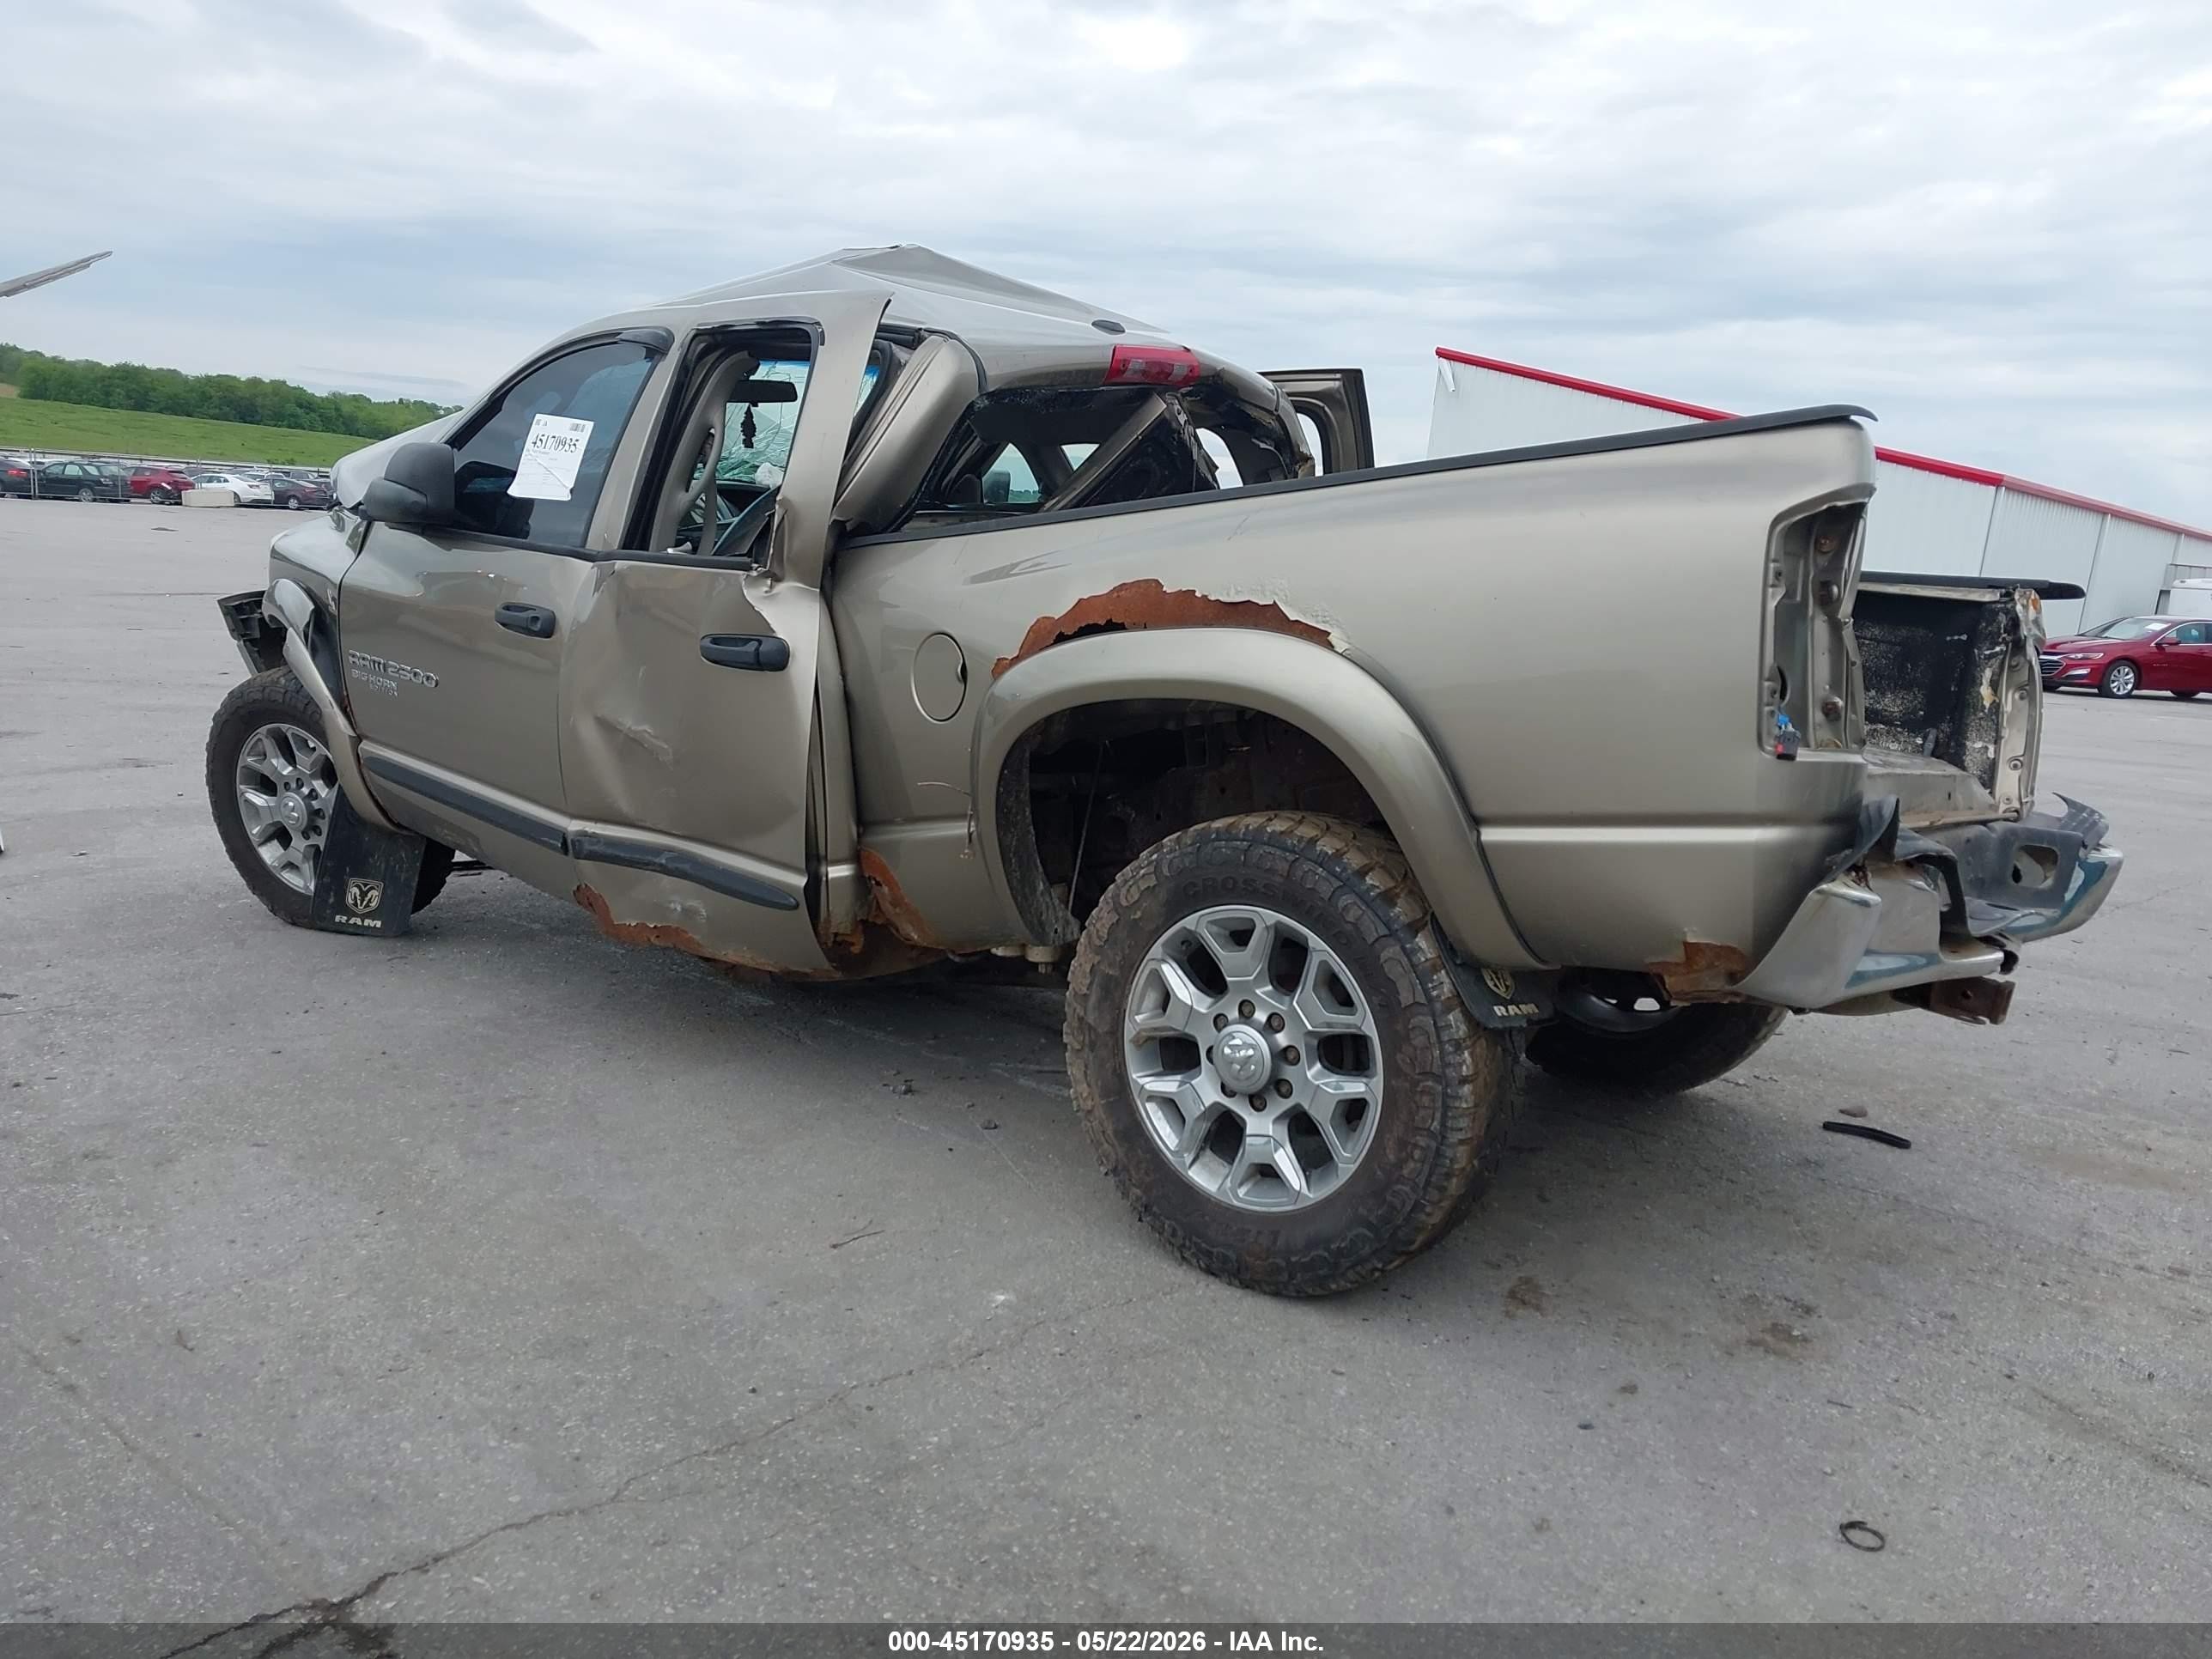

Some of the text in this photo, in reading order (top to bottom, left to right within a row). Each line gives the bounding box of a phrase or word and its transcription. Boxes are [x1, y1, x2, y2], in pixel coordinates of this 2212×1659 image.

[532, 433, 579, 453] 45170935
[349, 649, 440, 688] RAM 2500
[334, 915, 382, 928] RAM
[1492, 1003, 1540, 1017] RAM
